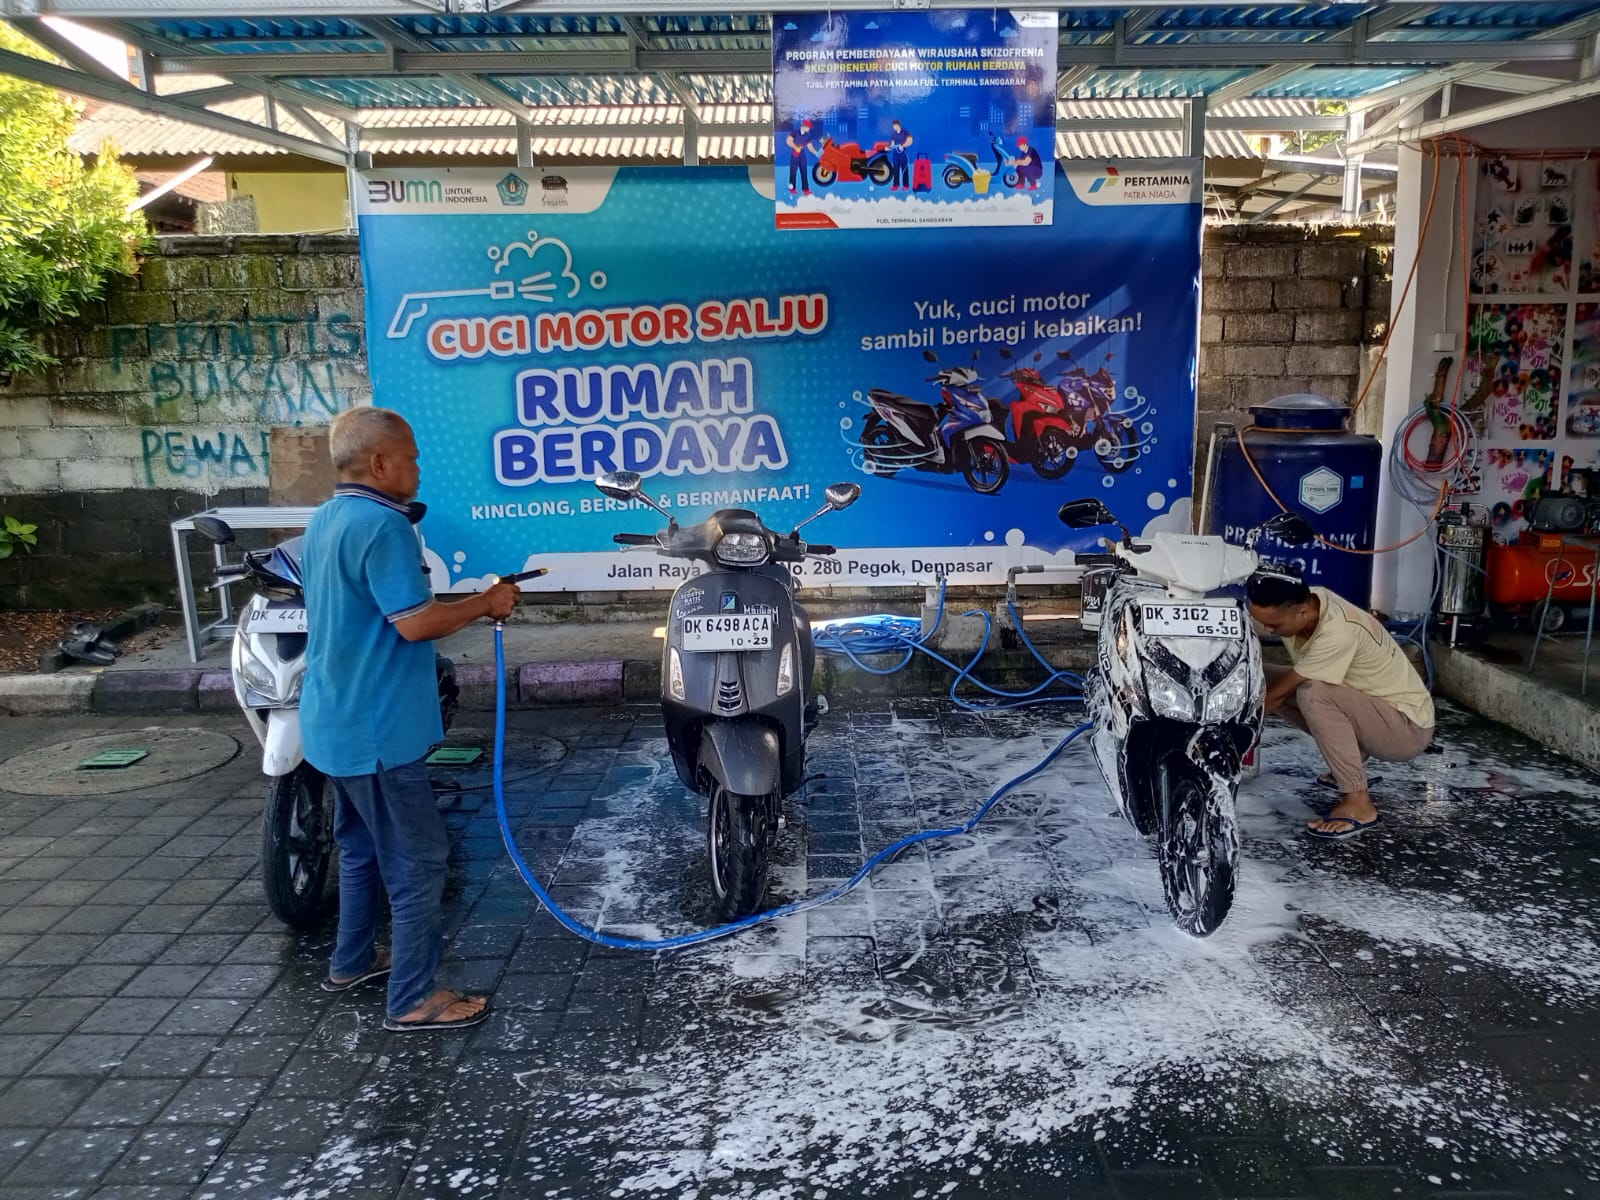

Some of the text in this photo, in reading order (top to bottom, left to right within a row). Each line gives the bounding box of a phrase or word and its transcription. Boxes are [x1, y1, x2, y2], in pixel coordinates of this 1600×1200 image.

[786, 47, 1044, 60] PROGRAM PEMBERDAYAAN WIRAUSAHA SKIZOFRENIA
[885, 62, 908, 72] CUCI
[910, 61, 943, 71] MOTOR
[946, 61, 980, 71] RUMAH
[982, 60, 1026, 71] BERDAYA
[806, 78, 1026, 89] TJSL PERTAMINA PATRA NIAGA FUEL TERMINAL SANGGARAN
[1124, 175, 1190, 187] PERTAMINA
[445, 187, 472, 195] UNTUK
[1123, 190, 1177, 200] PATRA NIAGA
[914, 292, 1091, 321] Yuk, cuci motor
[430, 296, 825, 356] CUCI MOTOR SALJU
[861, 312, 1142, 351] sambil berbagi kebaikan!
[150, 361, 339, 416] BUKAN
[520, 362, 748, 422] RUMAH
[498, 420, 784, 481] BERDAYA
[471, 501, 576, 521] KINCLONG,
[658, 494, 672, 509] &
[676, 484, 811, 508] BERMANFAAT!
[608, 563, 655, 579] Jalan
[659, 562, 701, 580] Raya
[813, 560, 842, 576] 280
[848, 558, 906, 578] Pegok,
[911, 557, 993, 577] Denpasar
[251, 610, 269, 621] DK
[1145, 607, 1164, 620] DK
[684, 617, 769, 634] DK 6498 ACA
